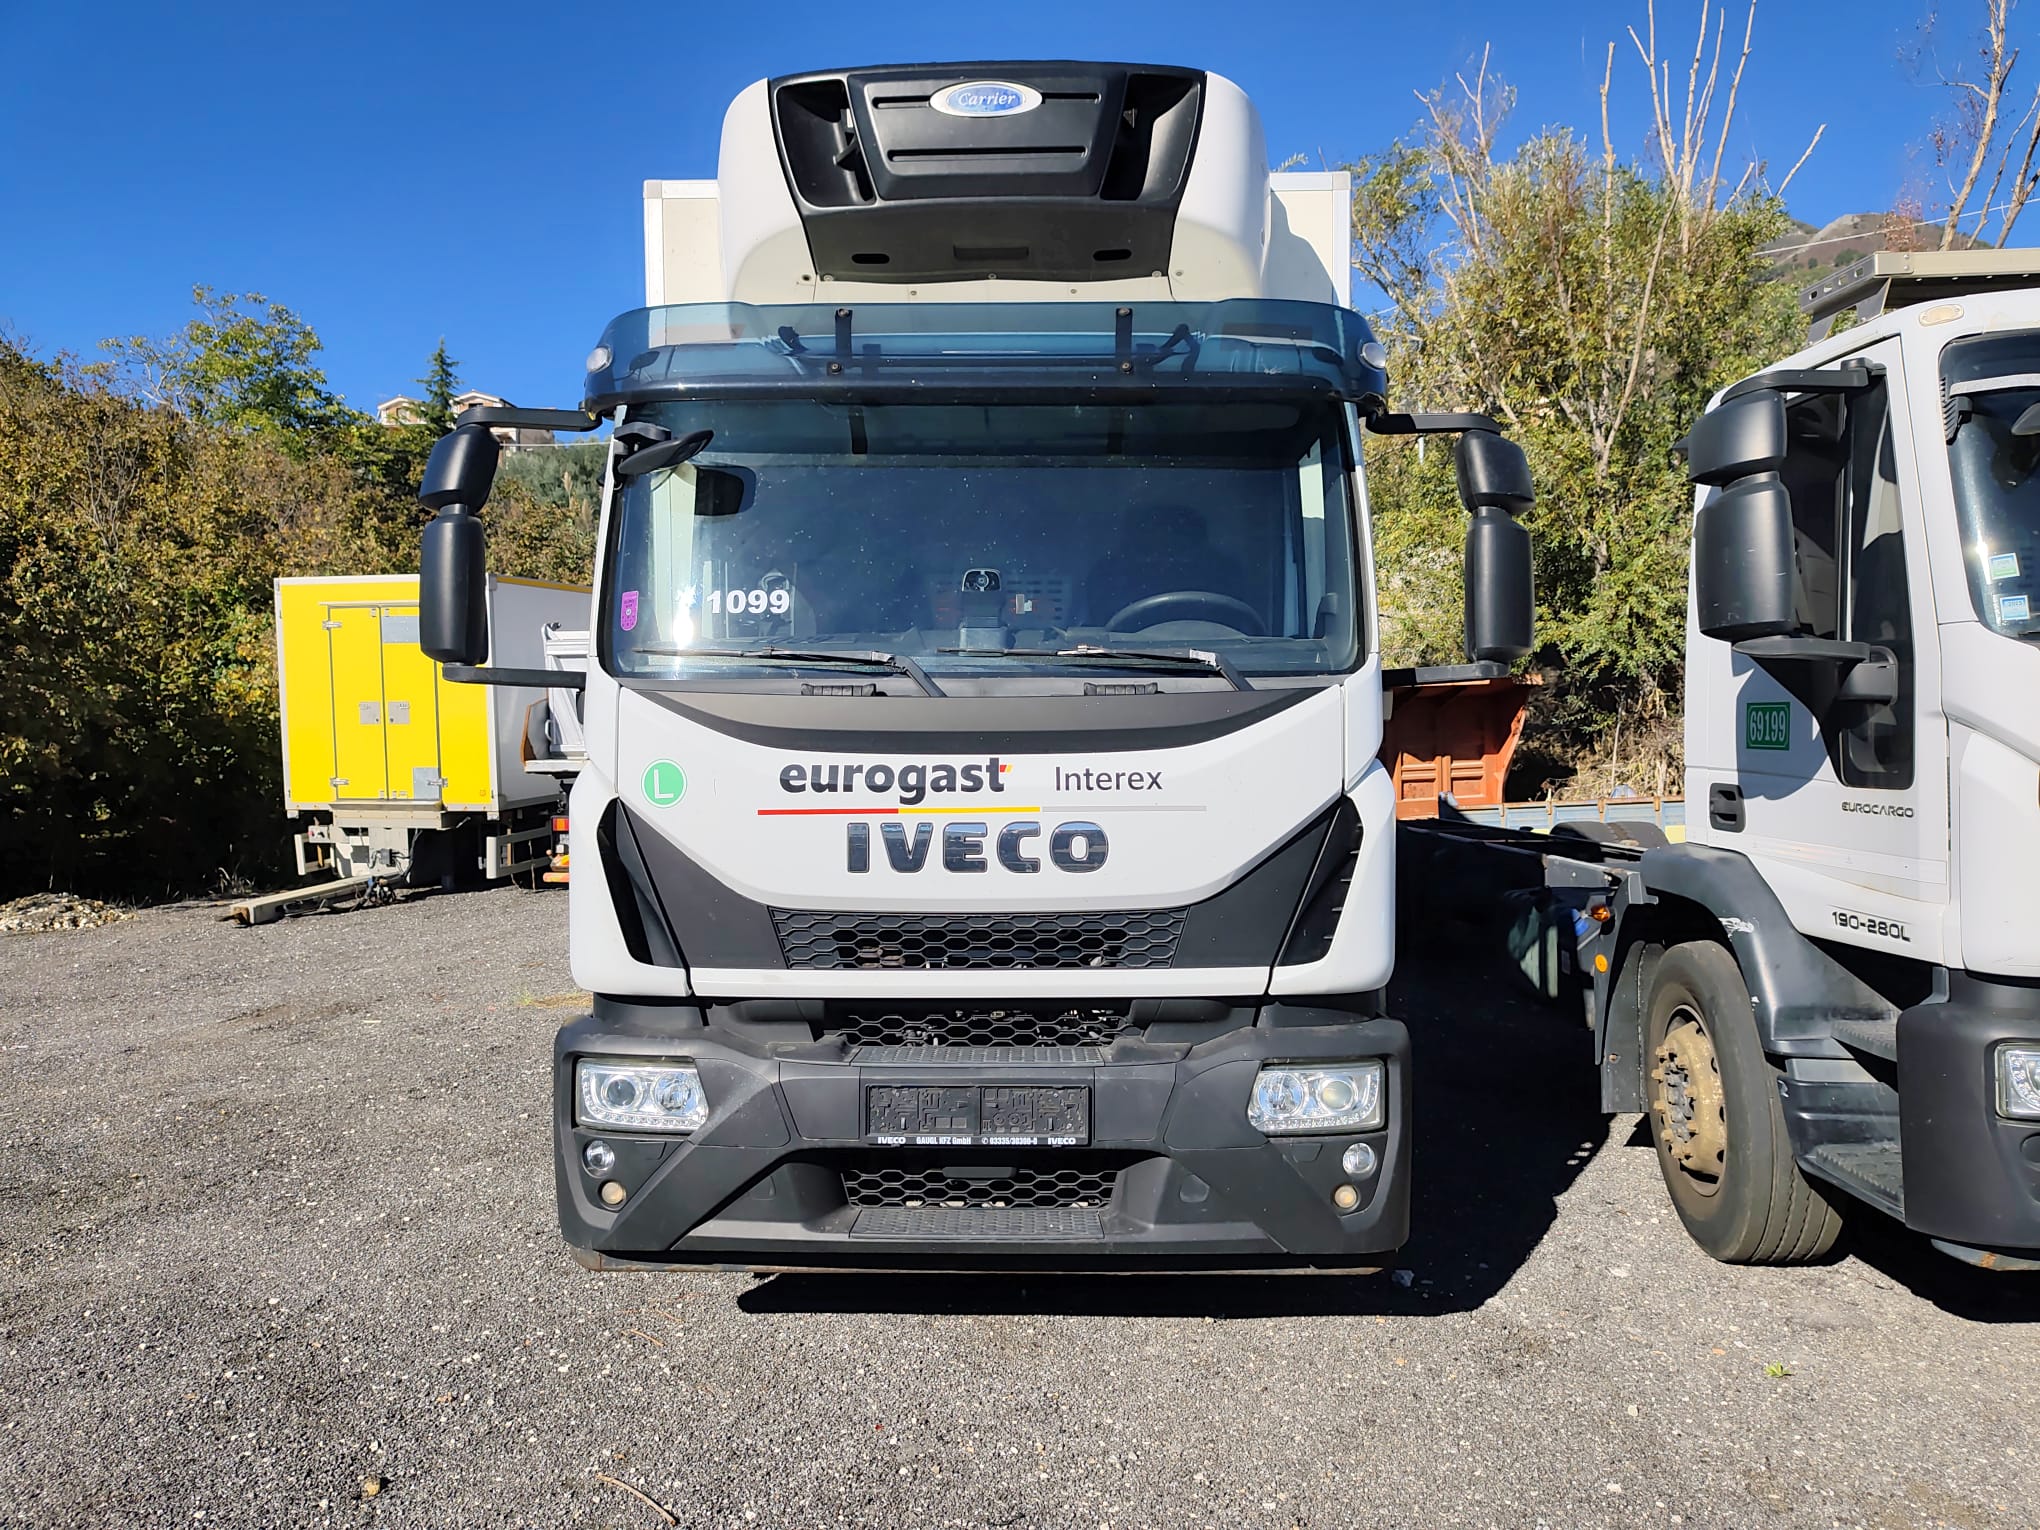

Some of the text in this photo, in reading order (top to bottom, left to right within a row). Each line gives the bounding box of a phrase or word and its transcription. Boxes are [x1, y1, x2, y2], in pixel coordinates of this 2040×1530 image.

[959, 92, 1016, 106] Carrier
[706, 589, 790, 614] 1099
[1749, 710, 1786, 742] 69199
[653, 769, 674, 799] L
[778, 757, 1164, 805] eurogast Interex
[1841, 801, 1914, 819] EUROCARGO
[846, 820, 1110, 874] IVECO
[1831, 911, 1911, 942] 190-280L
[877, 1136, 906, 1145] IVECO
[1047, 1137, 1076, 1145] IVECO
